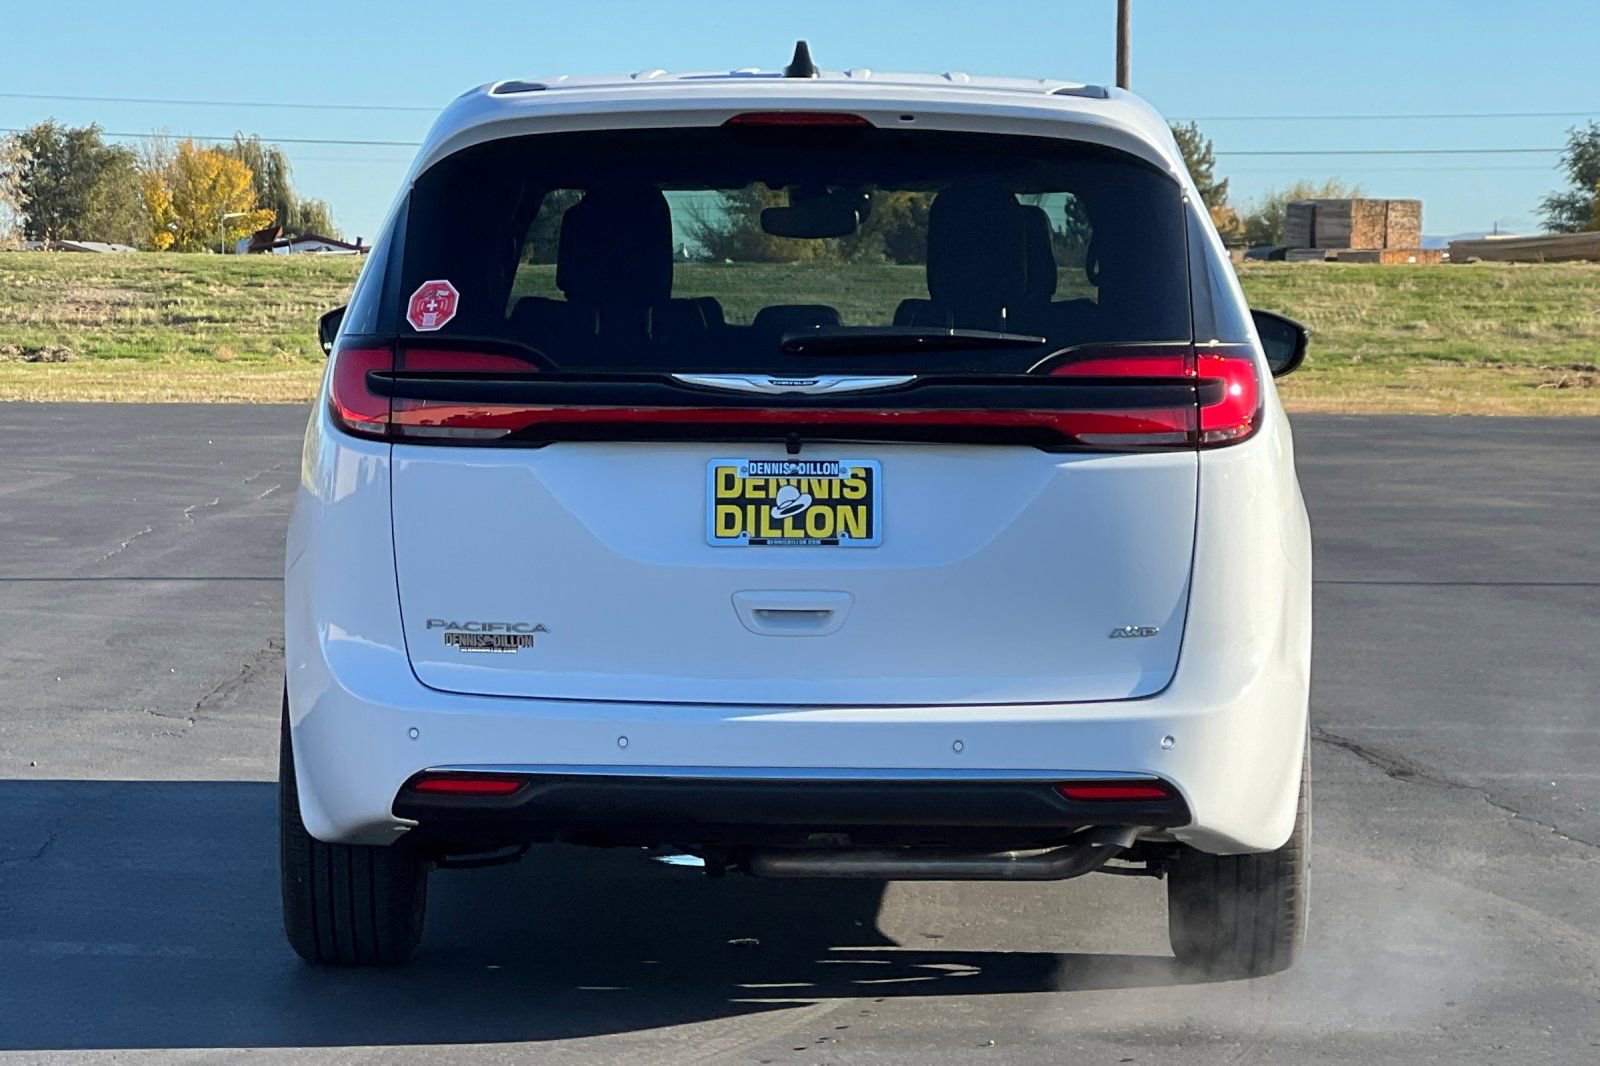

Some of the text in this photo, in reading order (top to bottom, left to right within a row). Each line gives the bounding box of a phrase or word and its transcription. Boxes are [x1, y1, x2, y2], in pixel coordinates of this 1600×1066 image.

[750, 462, 839, 475] DENNIS DILLON
[716, 504, 867, 539] DILLON
[426, 618, 552, 634] PACIFICA
[1108, 625, 1160, 639] AWD
[445, 632, 533, 648] DENNIS DILLON
